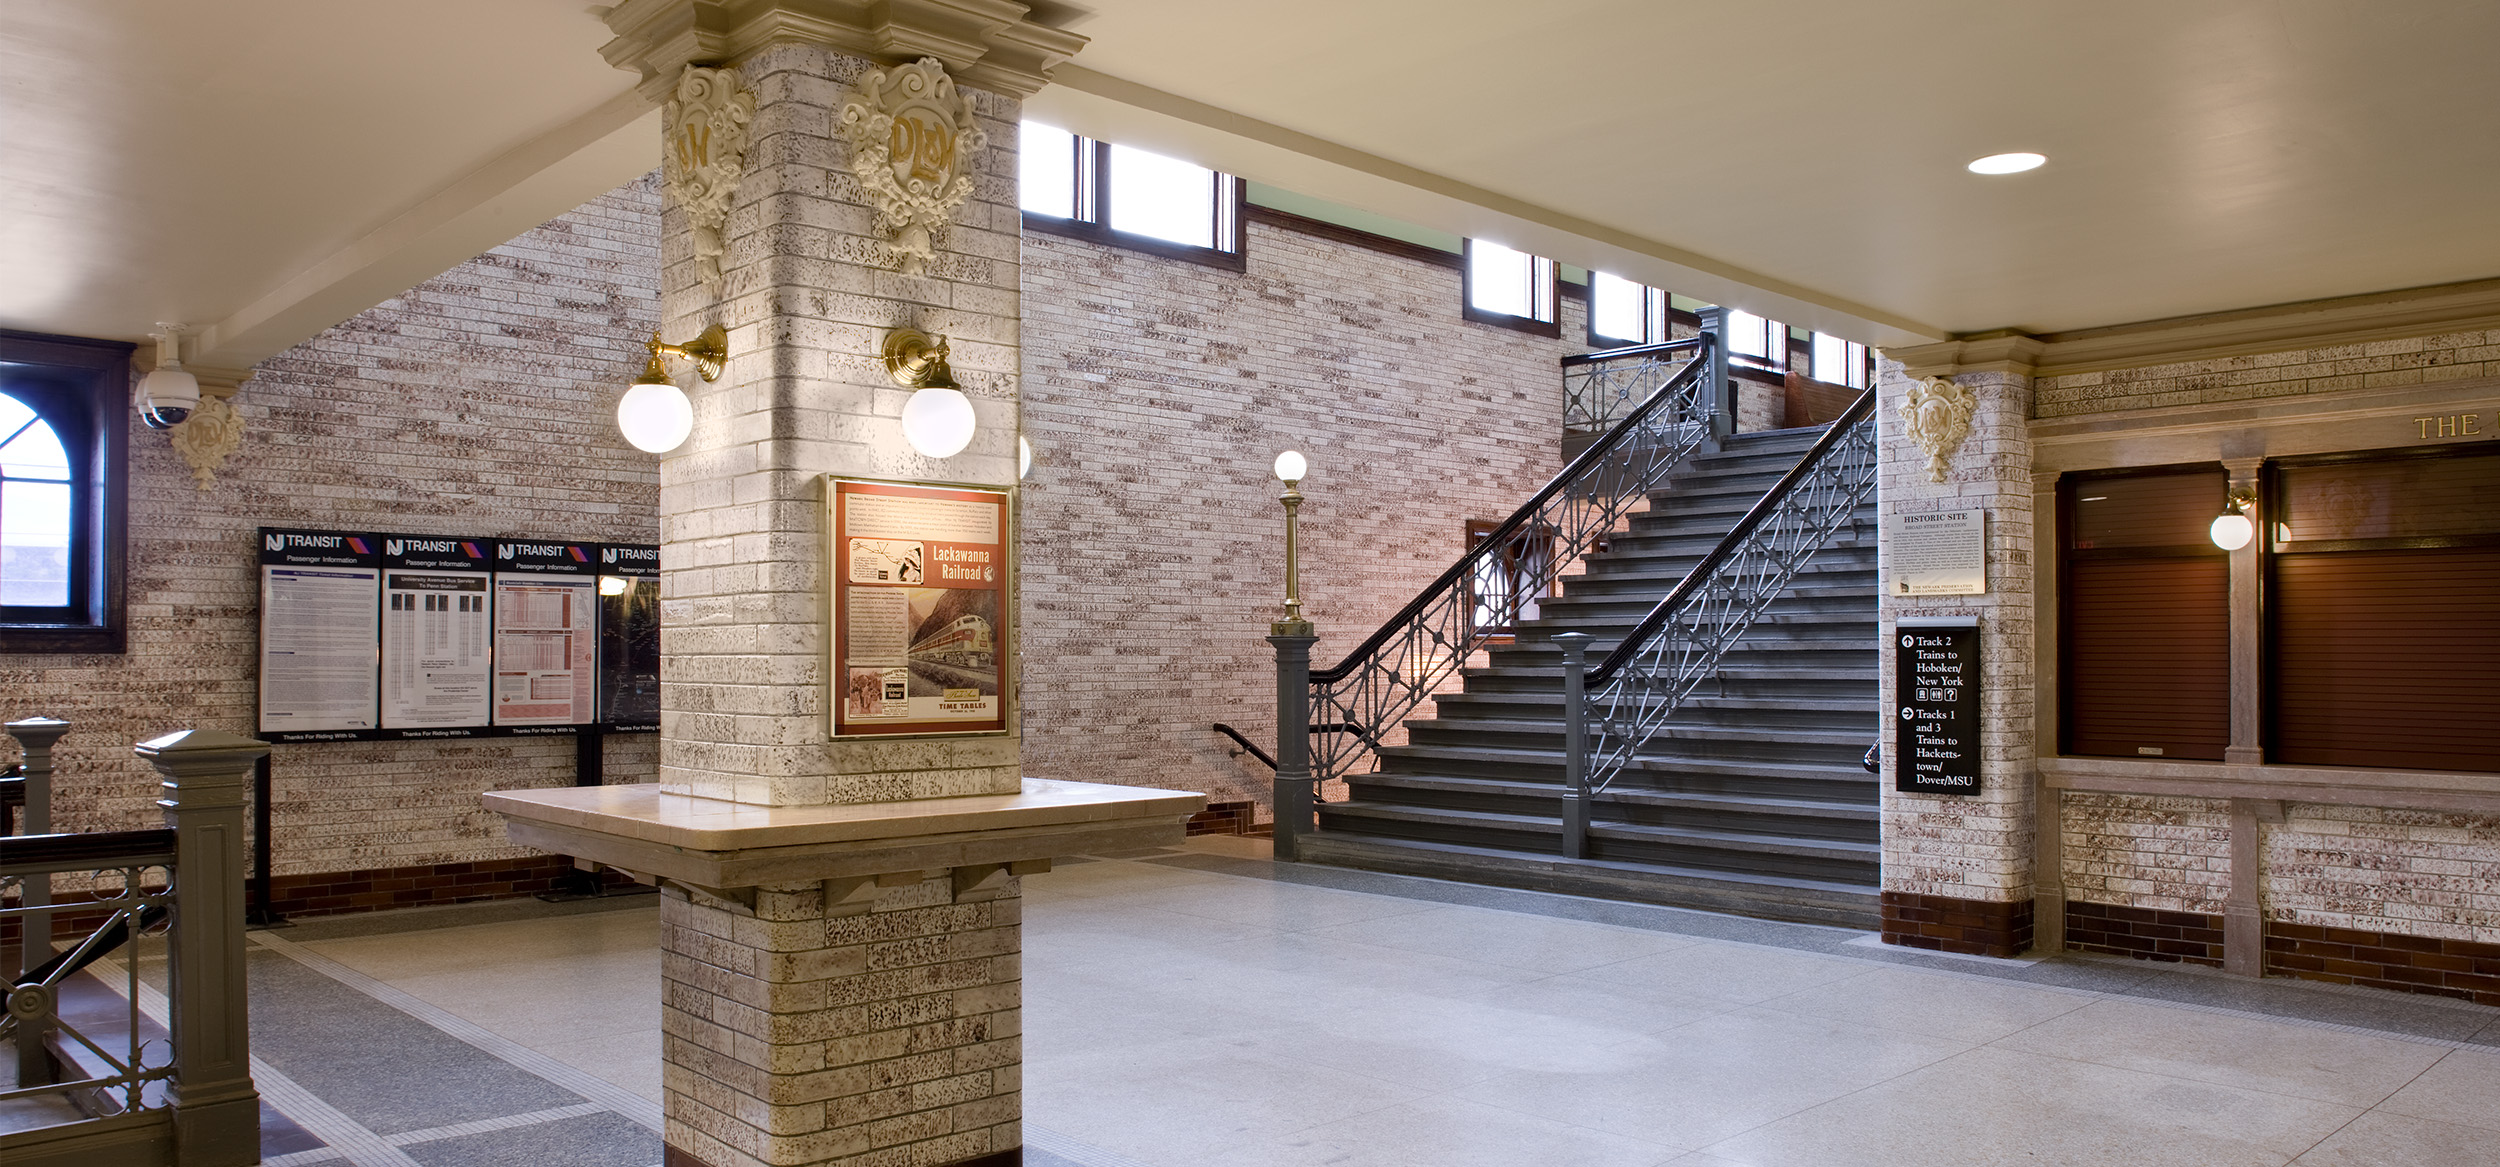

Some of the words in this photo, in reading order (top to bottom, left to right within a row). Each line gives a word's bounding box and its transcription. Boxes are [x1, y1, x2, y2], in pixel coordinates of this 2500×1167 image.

[2413, 414, 2481, 439] THE
[1904, 514, 1945, 523] HISTORIC
[266, 534, 285, 552] NJ
[286, 535, 342, 548] TRANSIT
[387, 539, 404, 556] NJ
[405, 540, 457, 552] TRANSIT
[498, 544, 515, 560] NJ
[516, 544, 564, 556] TRANSIT
[602, 548, 617, 564] NJ
[934, 545, 990, 563] Lackawanna
[287, 555, 320, 563] Passenger
[323, 556, 358, 564] Information
[406, 559, 437, 567] Passenger
[516, 563, 545, 571] Passenger
[943, 564, 981, 580] Railroad
[1916, 636, 1943, 646] Track
[1946, 637, 1952, 646] 2
[1916, 650, 1945, 659] Trains
[1917, 663, 1963, 674] Hoboken/
[1917, 676, 1938, 686] New
[1941, 676, 1964, 686] York
[1916, 709, 1947, 719] Tracks
[1950, 711, 1955, 719] 1
[1916, 722, 1933, 732] and
[1935, 723, 1941, 732] 3
[1916, 735, 1945, 745] Trains
[1916, 748, 1961, 759] Hacketts-
[1916, 762, 1943, 773] town/
[1916, 774, 1973, 786] Dover/MSU
